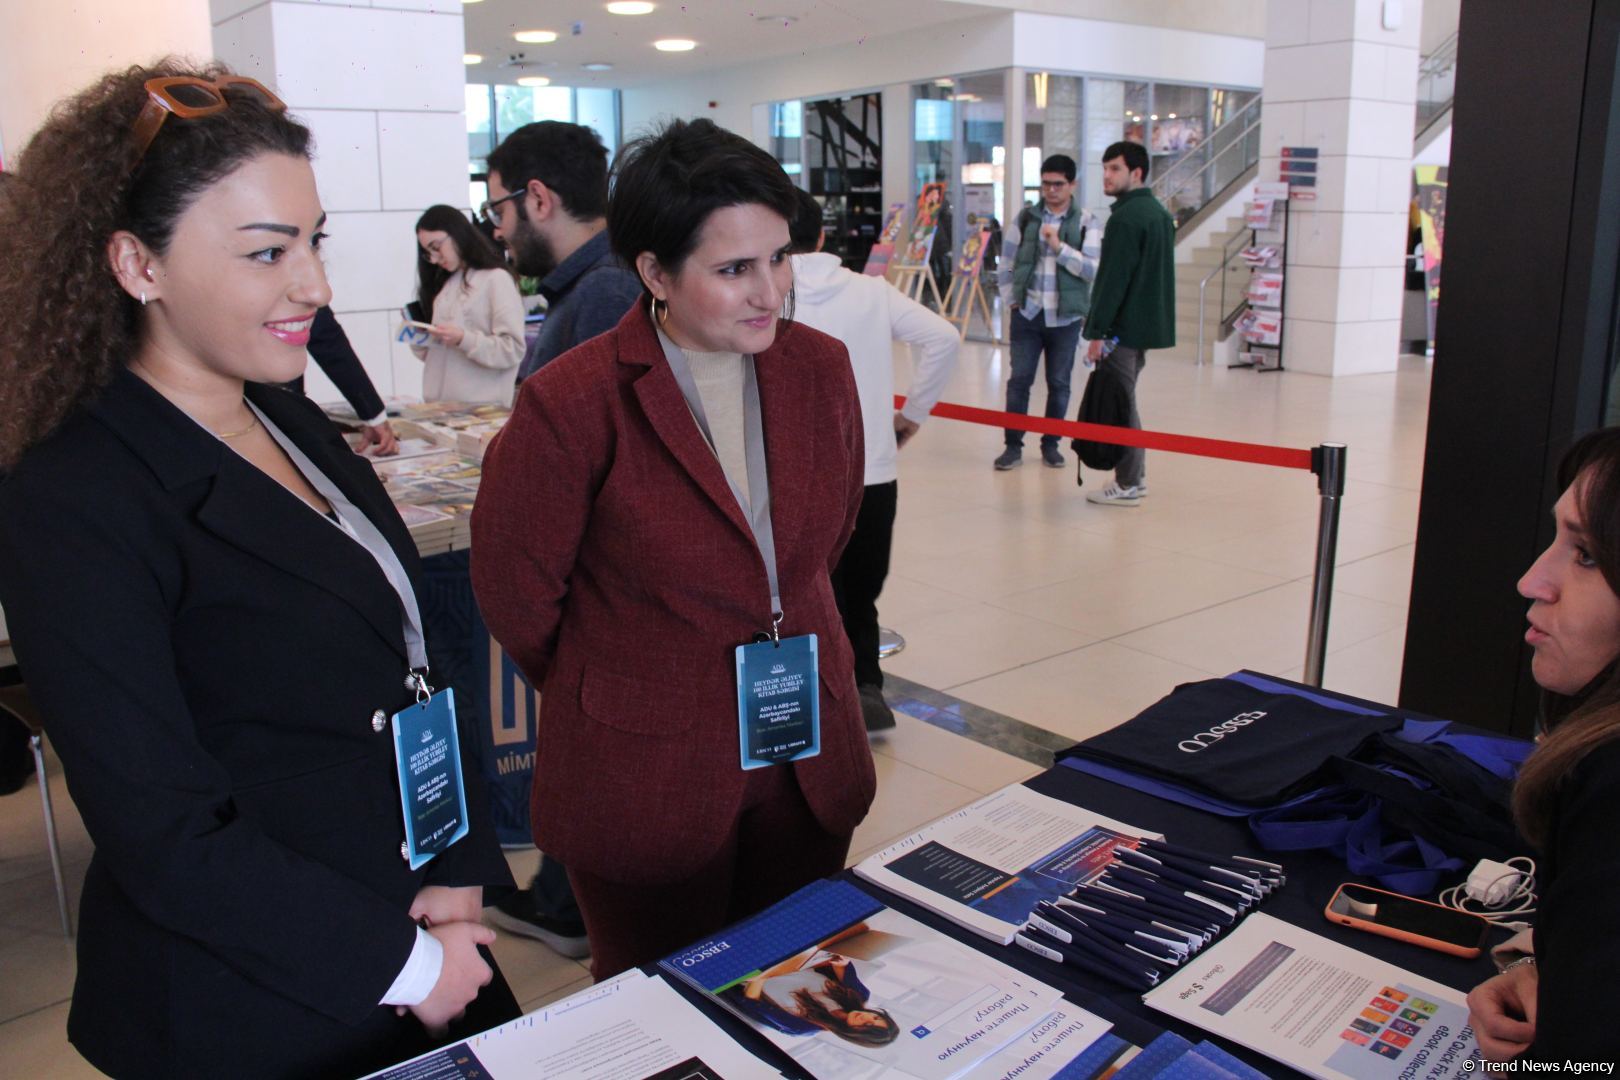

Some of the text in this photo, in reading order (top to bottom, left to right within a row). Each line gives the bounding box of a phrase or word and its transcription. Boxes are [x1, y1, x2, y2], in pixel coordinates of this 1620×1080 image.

[682, 941, 731, 967] EBSCO
[975, 993, 1014, 1022] работу?
[938, 1003, 1030, 1061] Пишете научную
[1031, 1011, 1067, 1044] работу?
[1043, 1021, 1085, 1052] Пишете
[1424, 1025, 1449, 1051] eBook
[1440, 1041, 1466, 1065] Quick
[1430, 1063, 1450, 1077] Fix
